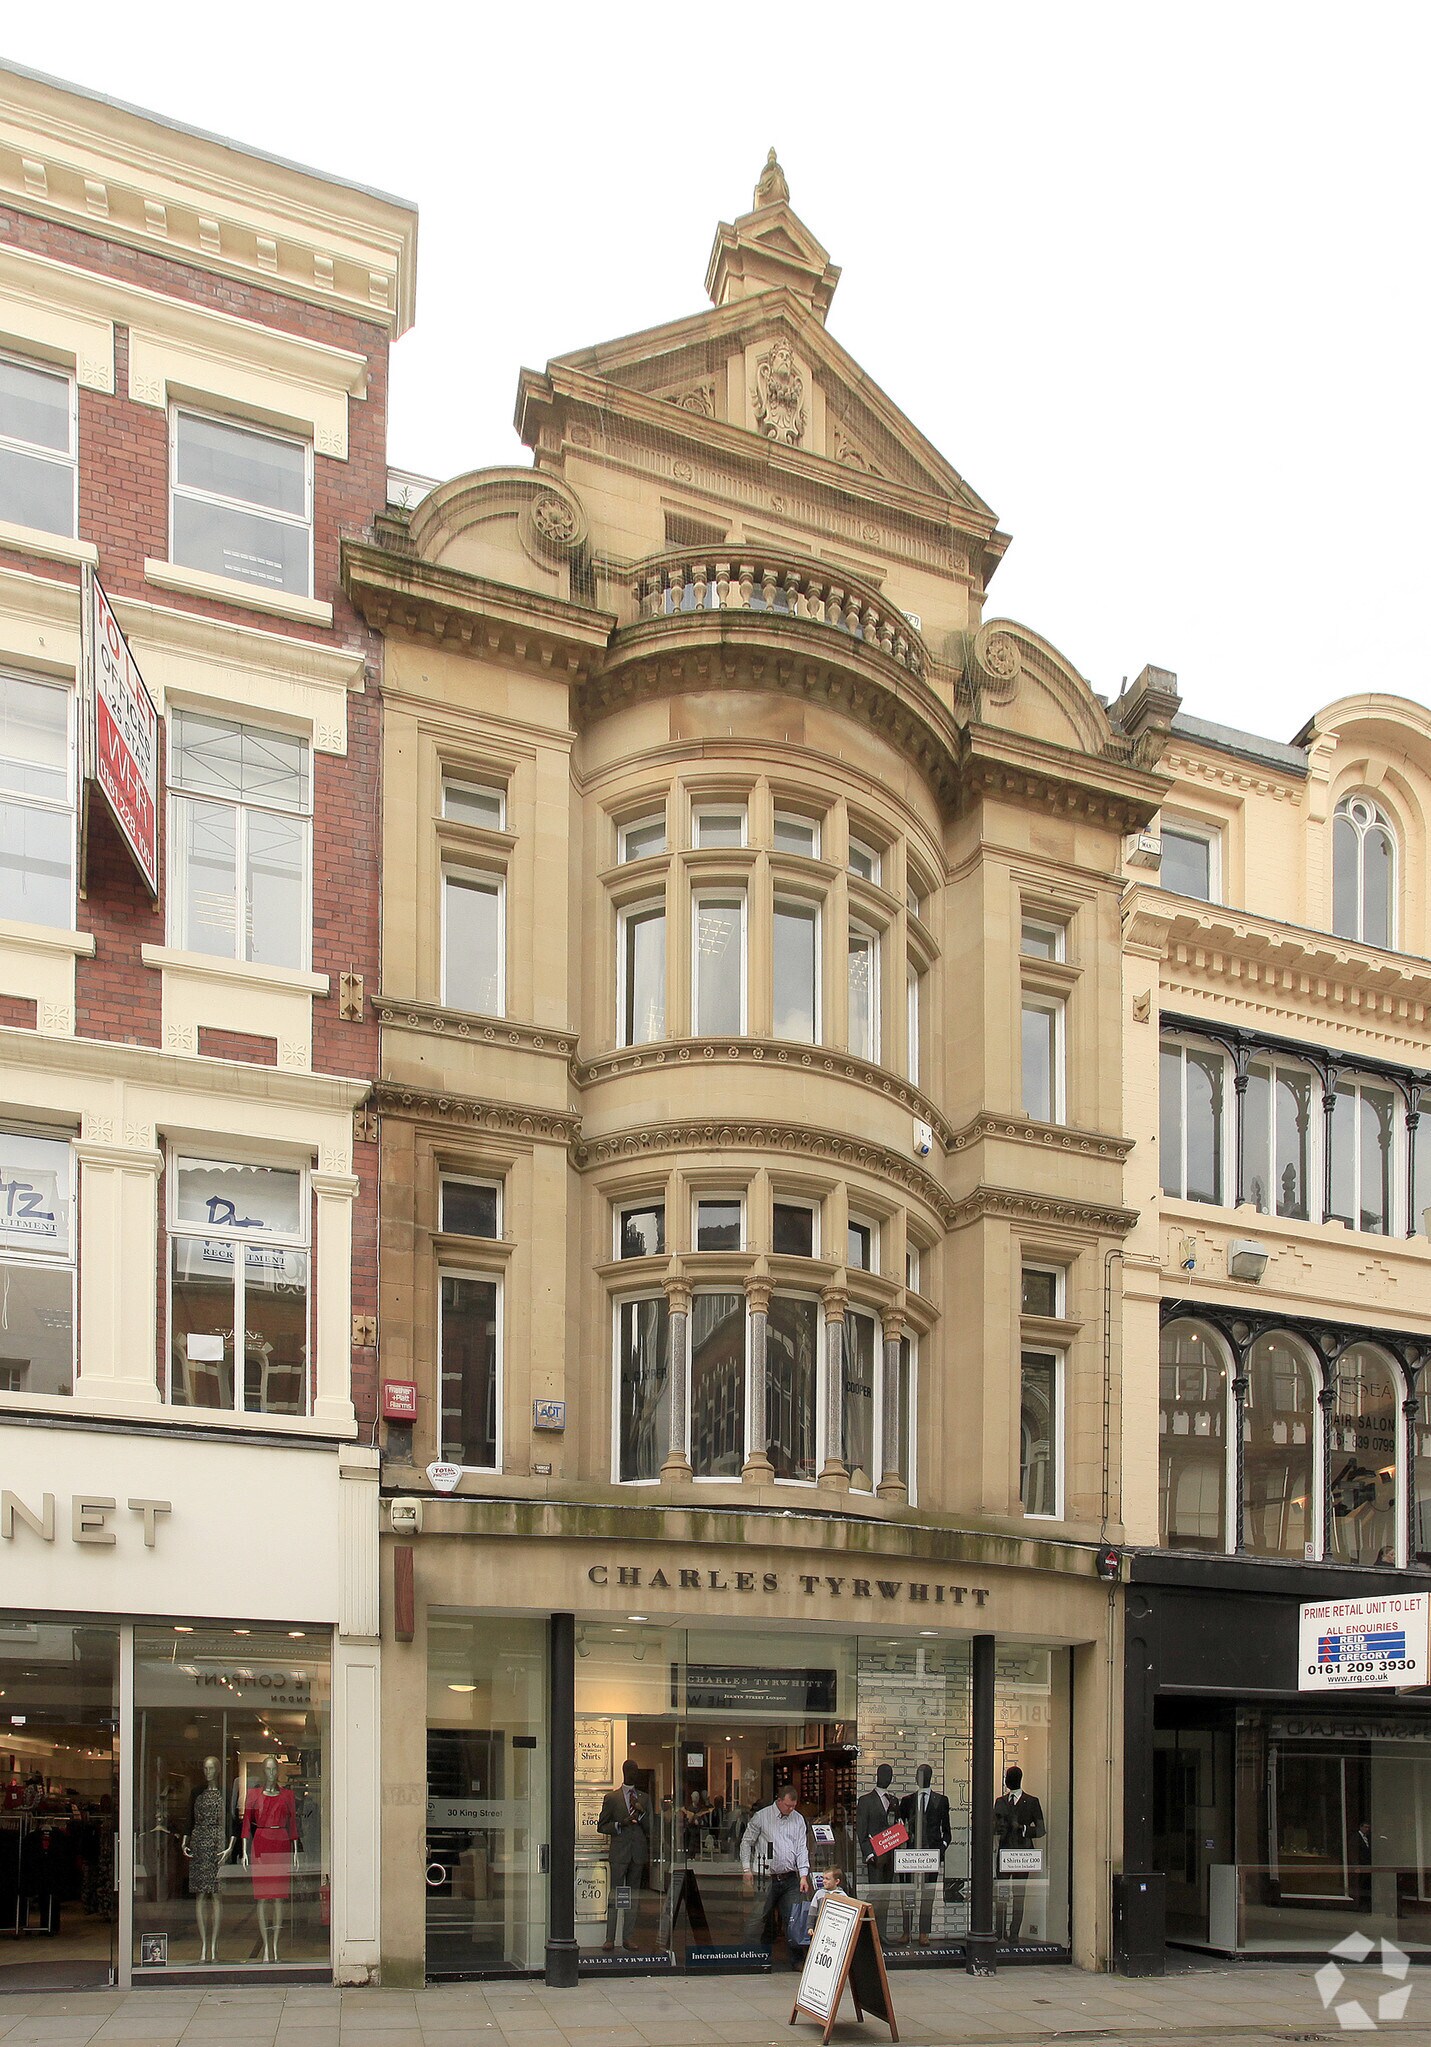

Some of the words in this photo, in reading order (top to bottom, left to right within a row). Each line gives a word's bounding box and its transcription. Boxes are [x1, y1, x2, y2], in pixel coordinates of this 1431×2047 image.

[95, 582, 119, 662] TO
[125, 653, 153, 738] LET
[101, 642, 151, 763] OFFICES
[103, 678, 123, 725] 1-25
[124, 723, 150, 780] STAFF
[106, 716, 148, 828] WHR
[100, 757, 119, 815] 0161
[119, 798, 136, 838] 228
[203, 1248, 286, 1265] RECRTMENT
[1359, 1416, 1395, 1432] SALON
[1373, 1438, 1394, 1453] 0799
[588, 1565, 778, 1593] CHARLES
[800, 1574, 990, 1606] TYRWHITT
[1304, 1606, 1330, 1620] PRIME
[1332, 1604, 1363, 1617] RETAIL
[1366, 1601, 1387, 1614] UNIT
[1389, 1600, 1401, 1612] TO
[1404, 1598, 1421, 1611] LET
[1326, 1626, 1344, 1635] ALL
[1346, 1622, 1398, 1634] ENQUIRIES
[1339, 1635, 1365, 1643] REID
[1339, 1643, 1368, 1652] ROSE
[1338, 1651, 1390, 1661] GREGORY
[1308, 1663, 1341, 1675] 0161
[1347, 1662, 1374, 1673] 209
[1378, 1659, 1416, 1671] 3930
[687, 1675, 748, 1684] CHARLES
[754, 1678, 823, 1688] TYRWHITT
[1327, 1673, 1388, 1683] www.rrg.co.uk
[447, 1809, 458, 1817] 30
[459, 1809, 477, 1818] King
[480, 1809, 503, 1817] Street
[878, 1832, 900, 1846] Continues
[882, 1830, 892, 1838] Sale
[888, 1838, 900, 1848] Store
[577, 1877, 582, 1885] 2
[581, 1889, 602, 1899] £40
[692, 1952, 739, 1960] International
[741, 1952, 769, 1960] delivery
[815, 1952, 832, 1969] £100
